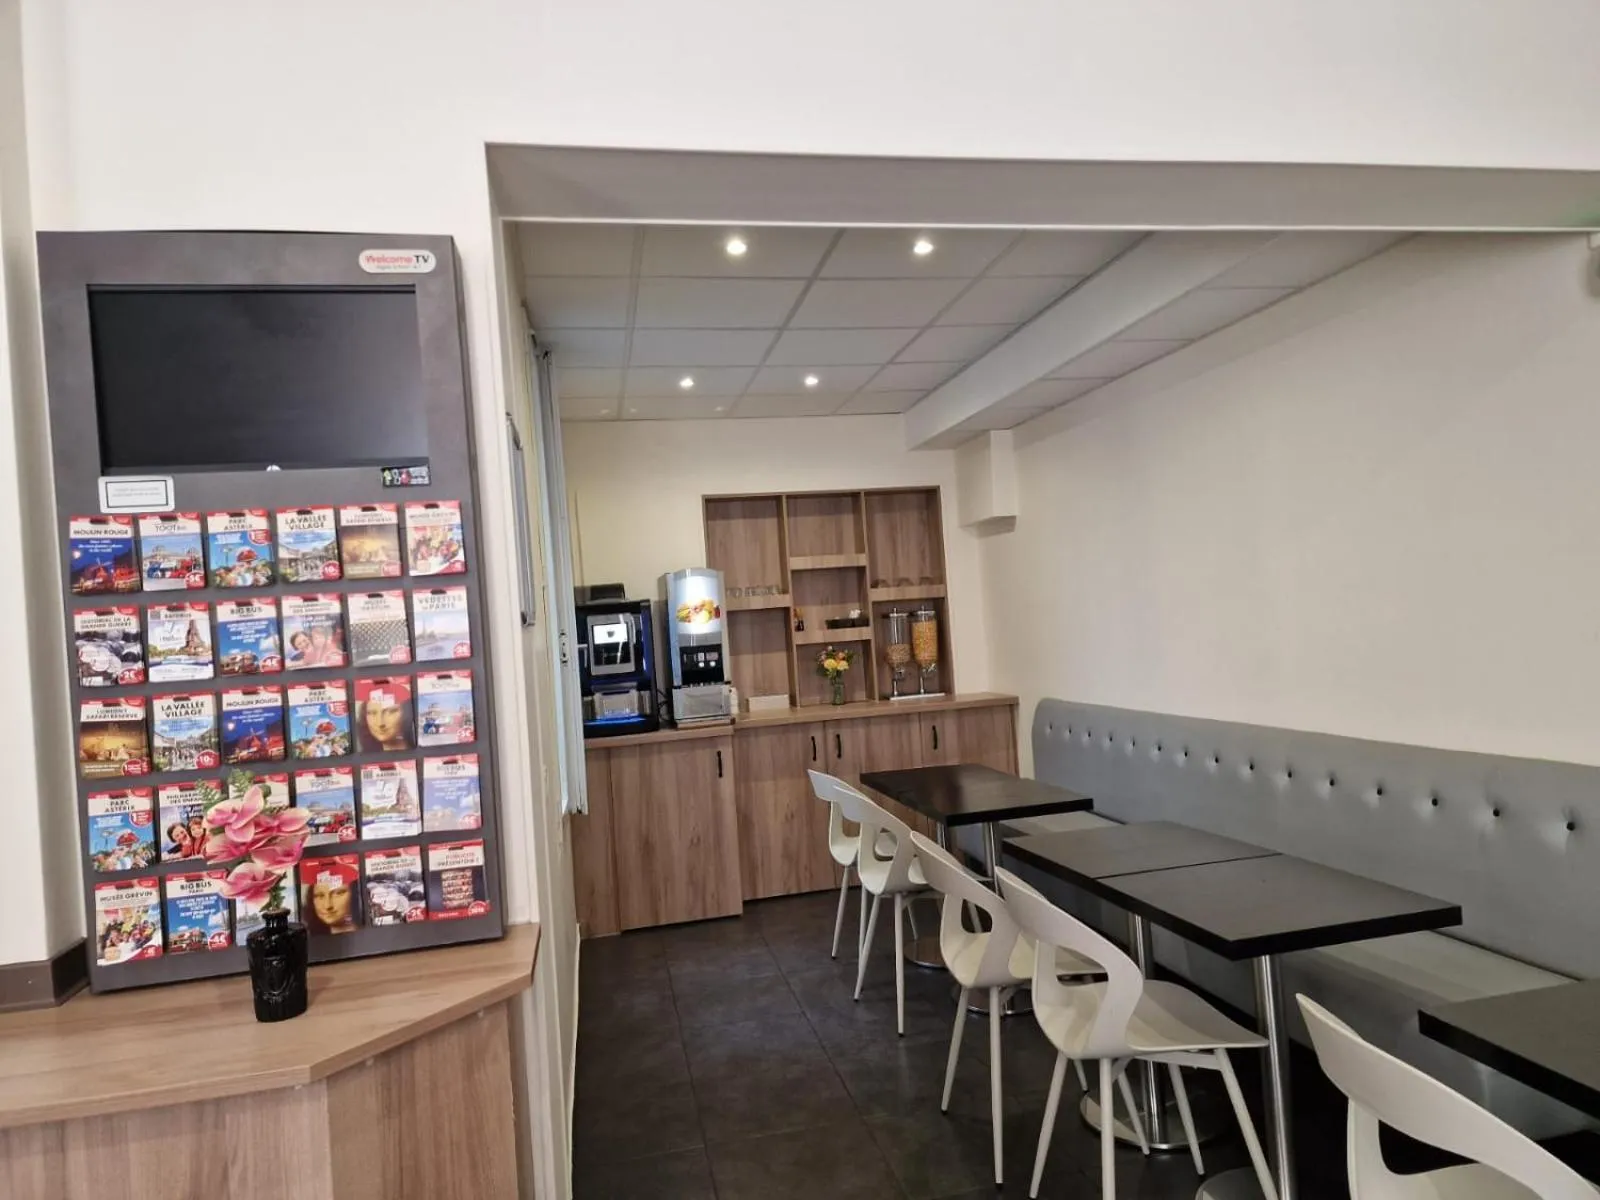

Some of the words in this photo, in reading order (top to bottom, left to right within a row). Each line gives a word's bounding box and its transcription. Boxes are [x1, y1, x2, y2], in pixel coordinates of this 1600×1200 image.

[414, 255, 429, 263] TV
[288, 522, 325, 530] VILLAGE
[165, 709, 203, 718] VILLAGE
[180, 882, 194, 890] BIG
[195, 881, 212, 889] BUS
